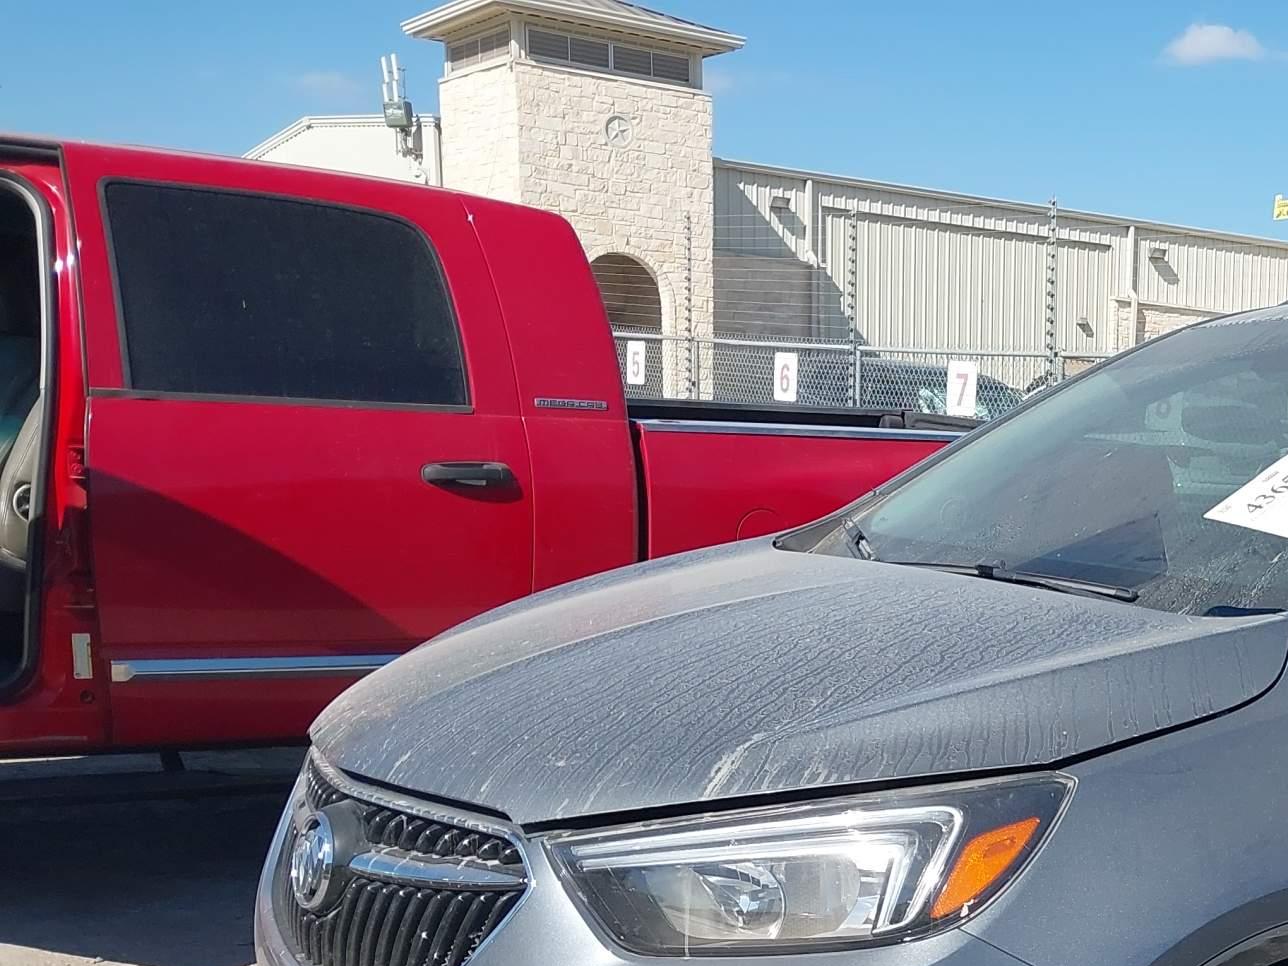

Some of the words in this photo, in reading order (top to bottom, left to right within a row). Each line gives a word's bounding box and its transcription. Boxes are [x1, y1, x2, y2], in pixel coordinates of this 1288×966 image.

[631, 351, 641, 378] 5
[779, 363, 791, 394] 6
[955, 372, 970, 407] 7
